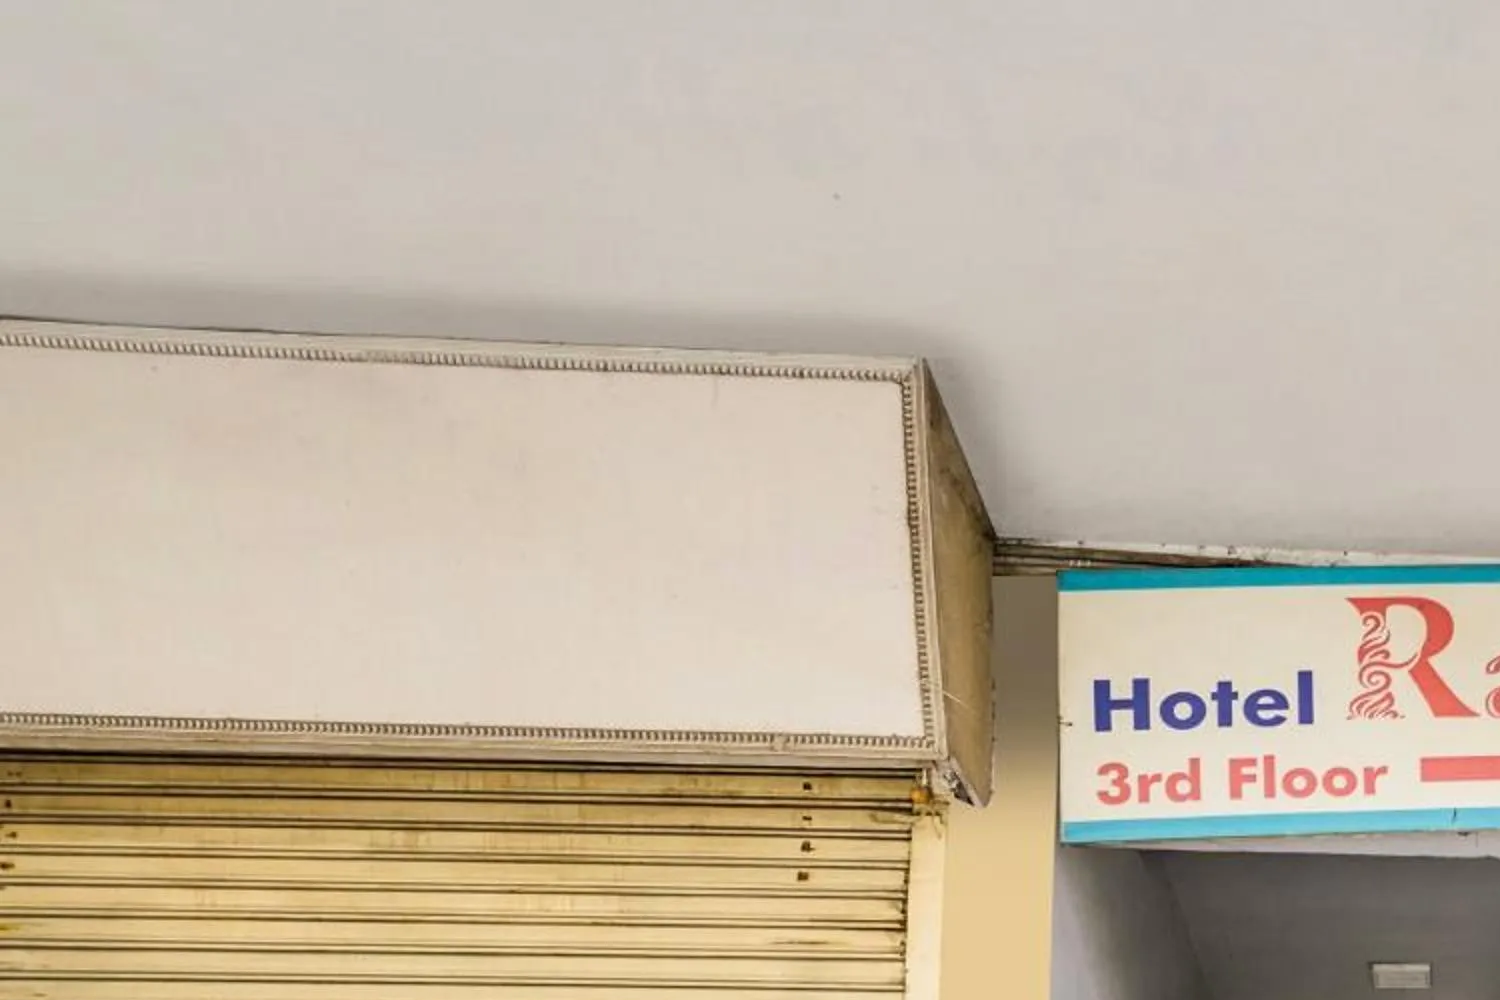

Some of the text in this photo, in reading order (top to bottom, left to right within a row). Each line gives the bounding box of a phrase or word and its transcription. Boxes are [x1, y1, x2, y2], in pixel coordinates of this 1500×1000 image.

[1093, 670, 1315, 733] Hotel
[1096, 754, 1389, 806] 3rd Floor
